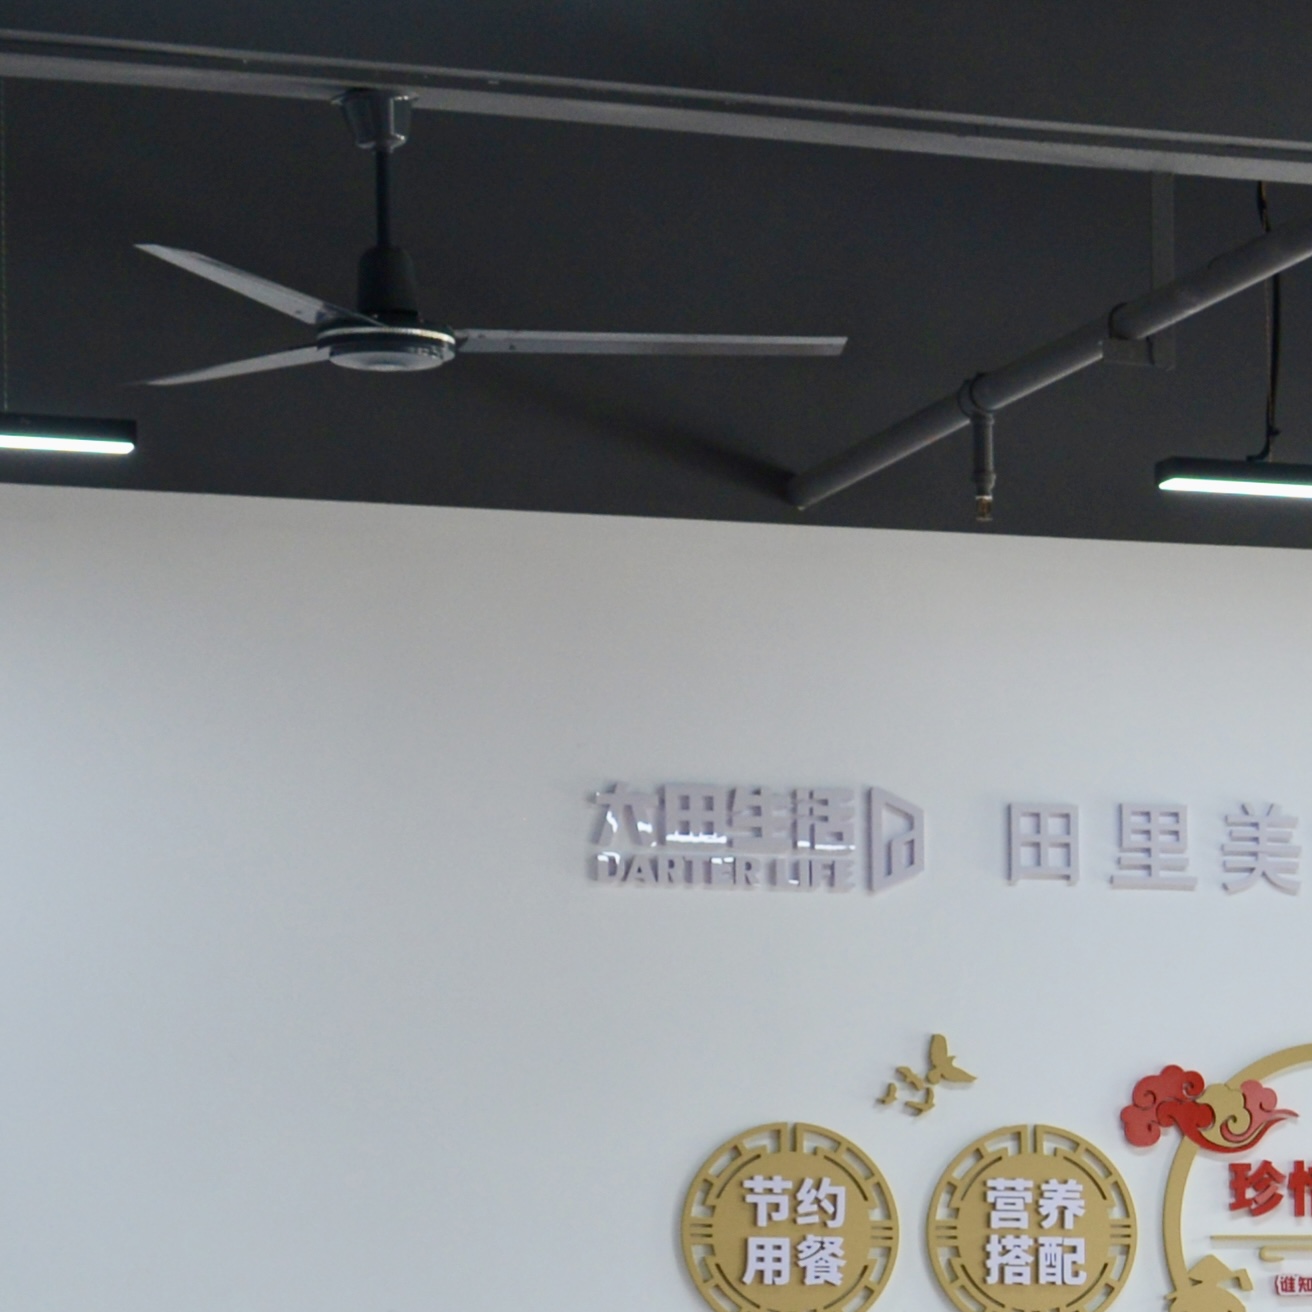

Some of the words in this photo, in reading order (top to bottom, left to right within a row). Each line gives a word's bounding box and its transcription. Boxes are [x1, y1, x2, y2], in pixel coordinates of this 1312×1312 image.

[588, 781, 856, 850] 大田生活
[587, 851, 762, 886] DARTER
[767, 854, 856, 890] LIFE
[742, 1175, 846, 1229] 节约
[986, 1177, 1086, 1231] 营养
[742, 1234, 846, 1287] 用餐
[986, 1234, 1087, 1287] 搭配
